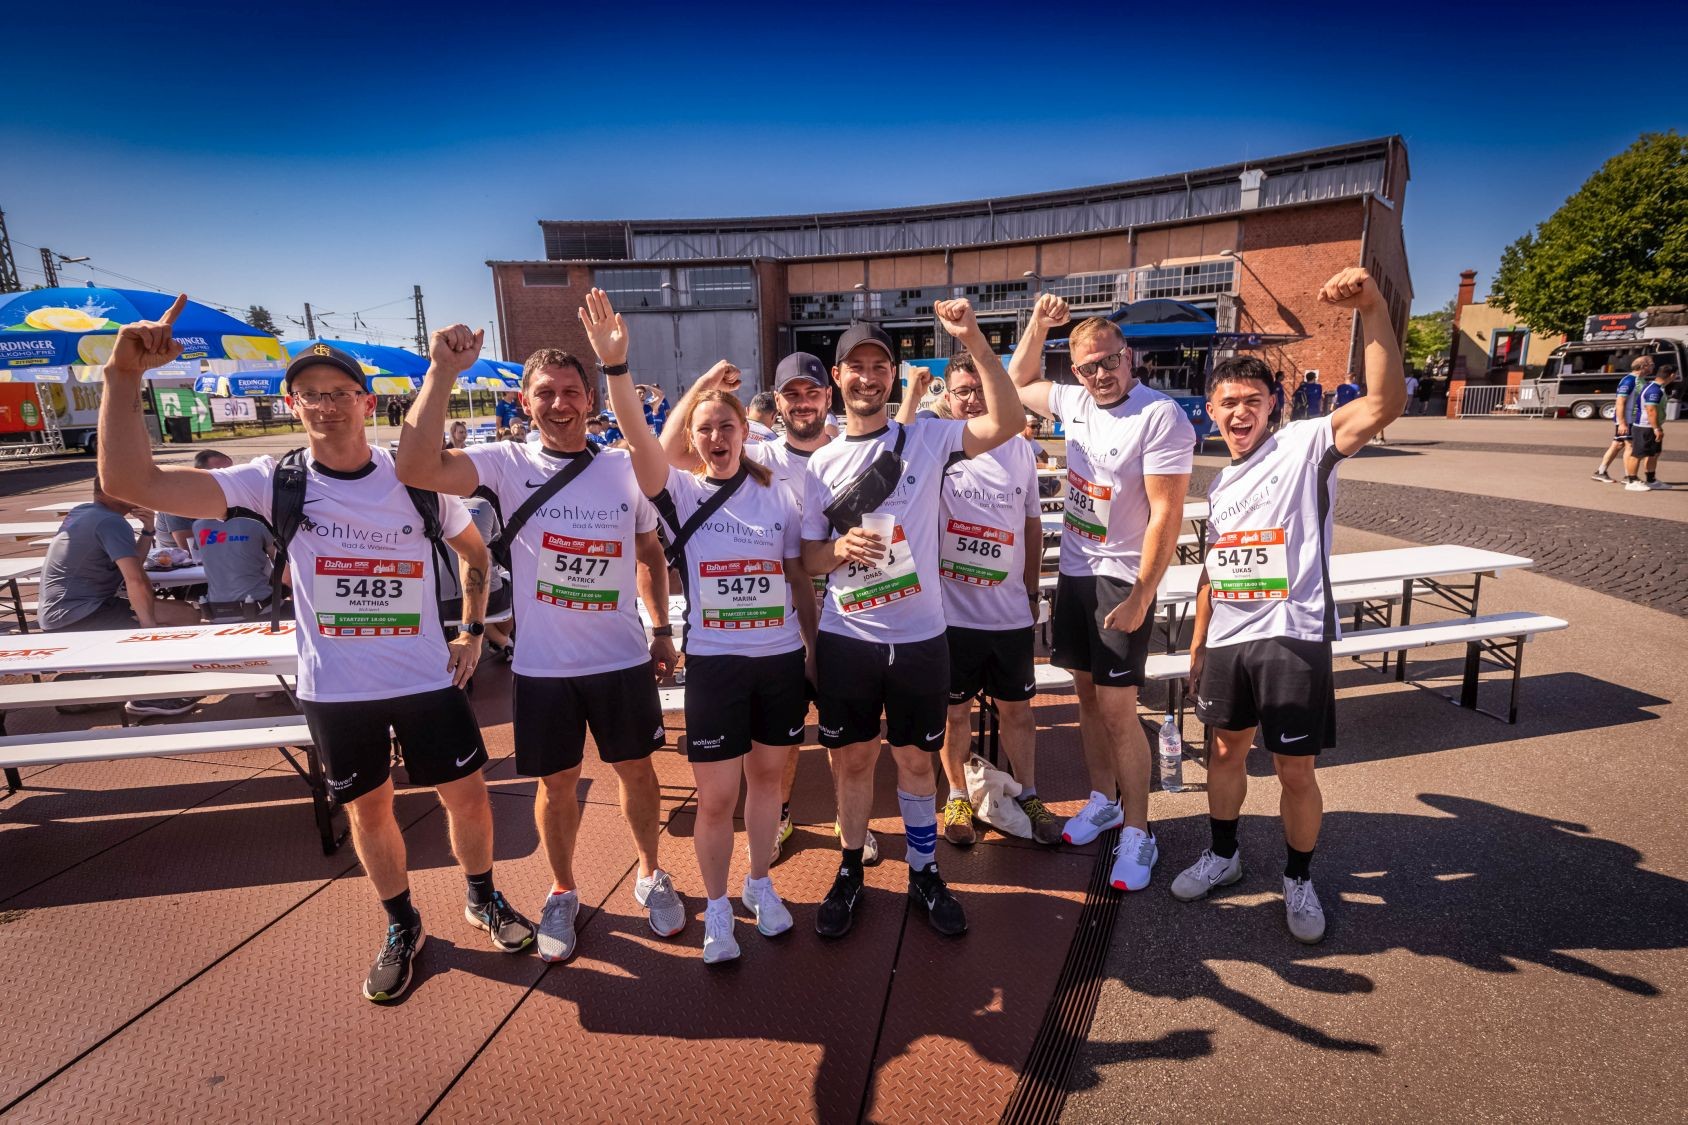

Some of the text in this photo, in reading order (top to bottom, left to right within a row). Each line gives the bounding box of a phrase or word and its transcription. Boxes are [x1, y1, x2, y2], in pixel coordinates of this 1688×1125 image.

[0, 340, 55, 351] RDINGER
[1068, 487, 1096, 513] 5481
[535, 505, 620, 521] wohlwert
[199, 529, 228, 547] TSG
[956, 537, 1001, 558] 5486
[555, 554, 609, 576] 5477
[1217, 548, 1268, 567] 5475
[567, 576, 595, 584] PATRICK
[863, 571, 883, 582] JONAS
[335, 579, 403, 598] 5483
[717, 577, 770, 595] 5479
